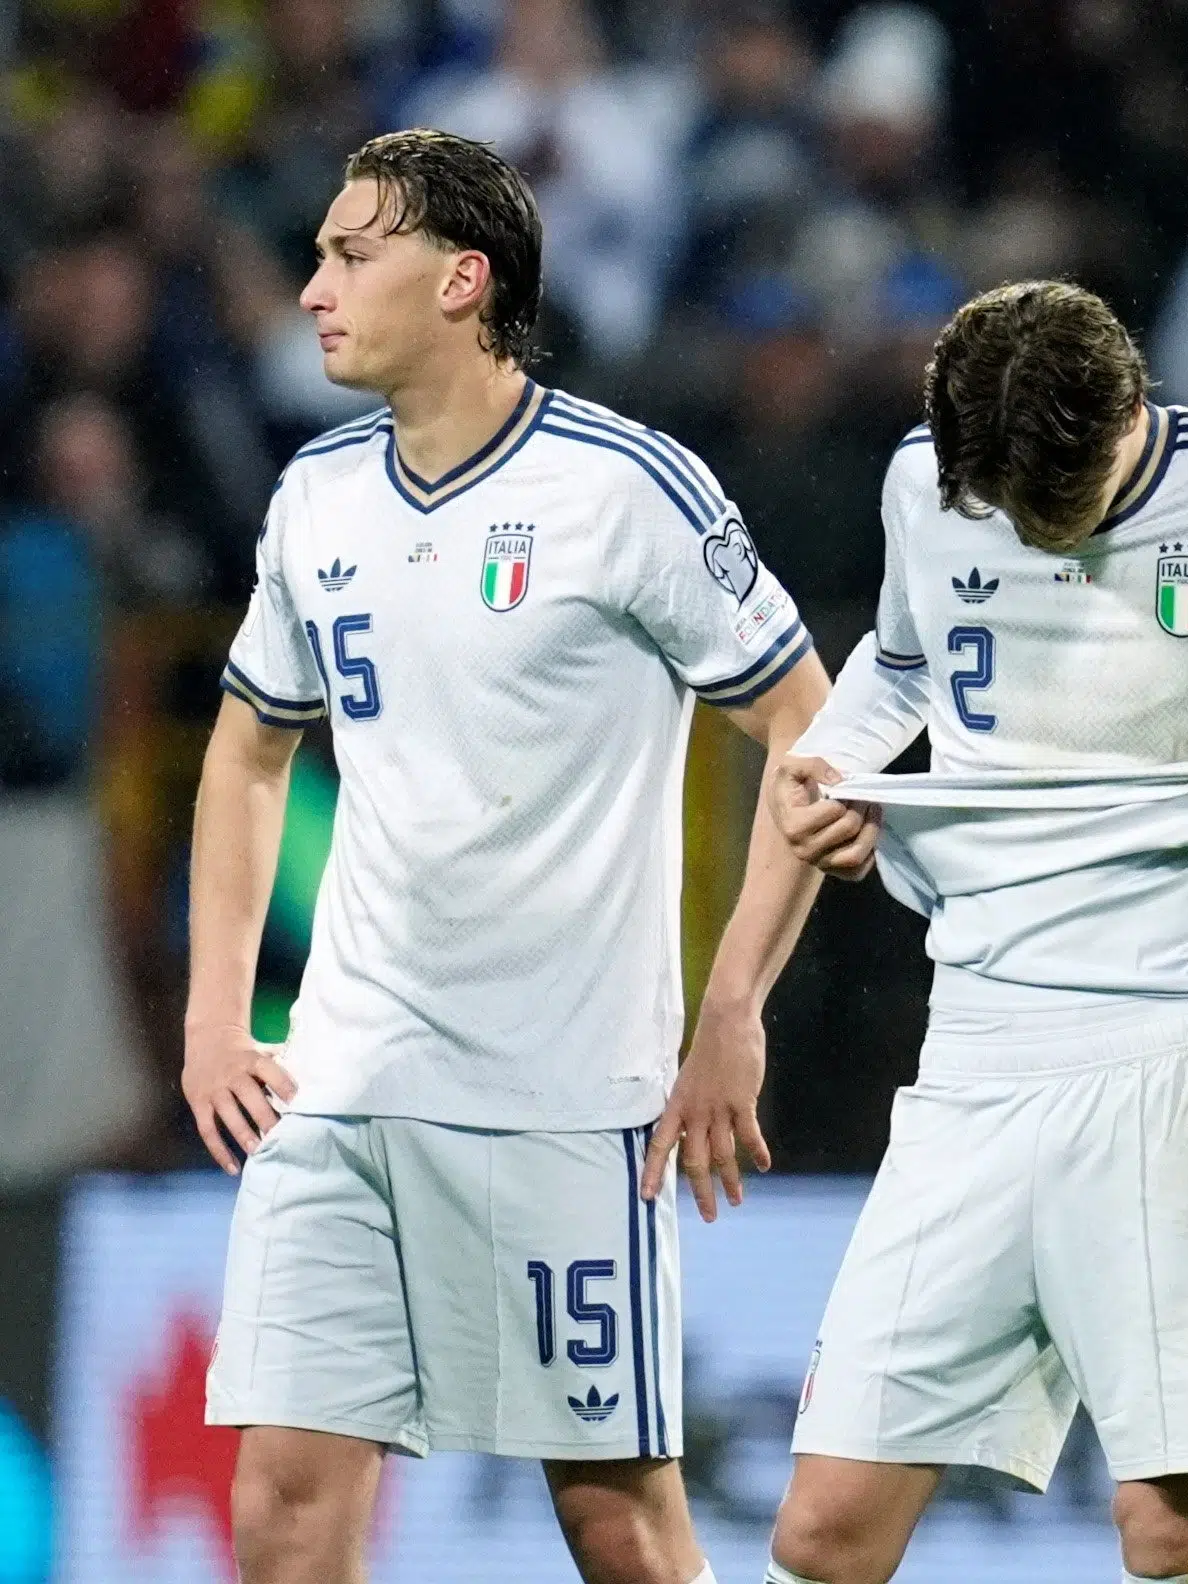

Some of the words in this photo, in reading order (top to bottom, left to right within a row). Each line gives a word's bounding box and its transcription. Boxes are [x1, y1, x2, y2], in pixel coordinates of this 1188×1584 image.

[488, 540, 527, 554] ITALIA
[305, 613, 383, 721] 15
[947, 626, 998, 733] 2
[527, 1259, 619, 1368] 15
